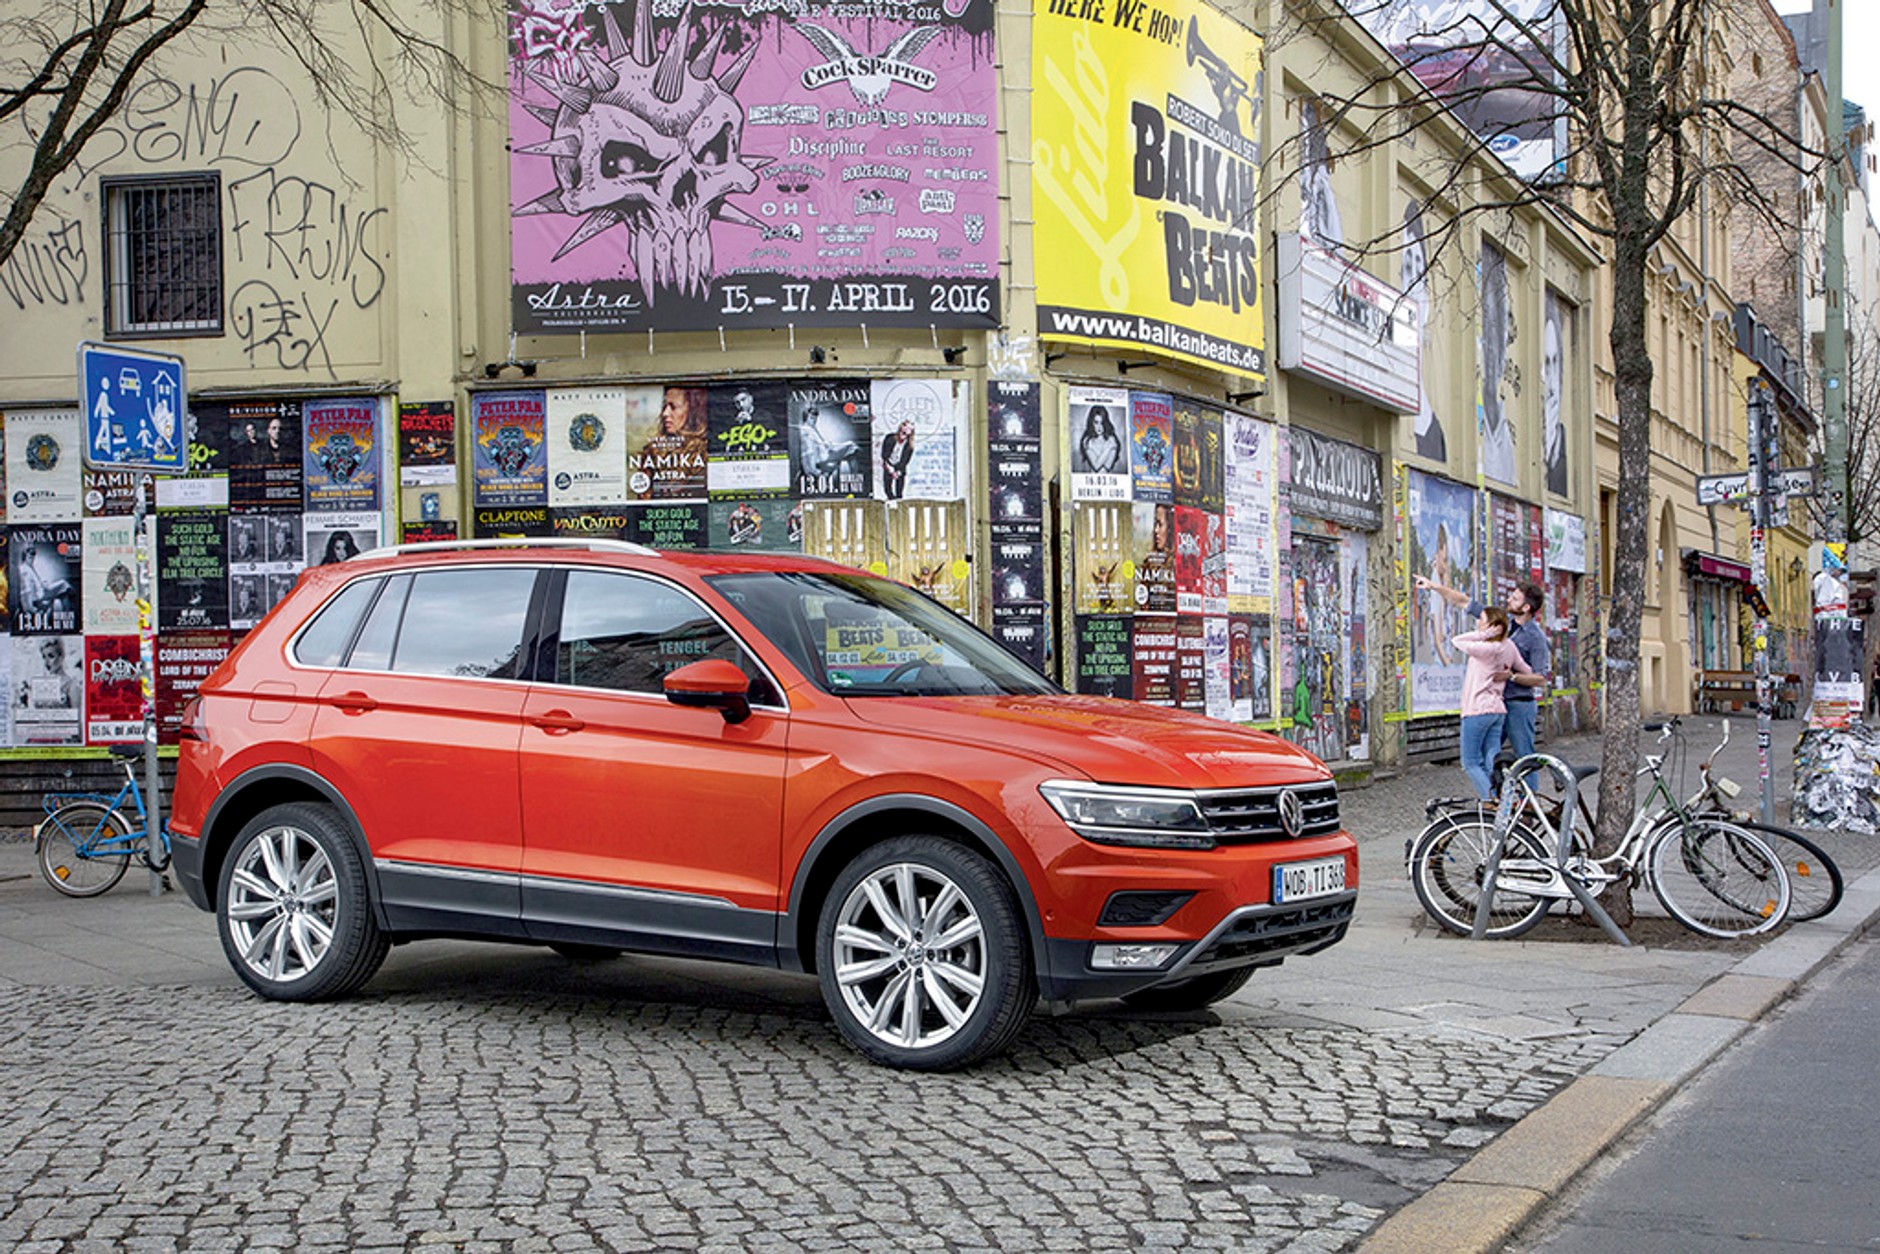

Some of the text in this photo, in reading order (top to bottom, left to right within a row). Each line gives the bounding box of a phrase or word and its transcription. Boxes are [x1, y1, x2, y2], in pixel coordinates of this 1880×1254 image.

[827, 5, 903, 19] FESTIVAL
[907, 7, 942, 21] 2016
[1113, 0, 1147, 33] WE
[1147, 9, 1184, 48] HOP!
[1168, 97, 1207, 134] ROBERT
[787, 136, 866, 160] Discipline
[886, 145, 973, 157] LAST RESORT
[1131, 100, 1255, 234] BALKAN
[1163, 210, 1257, 314] BEATS
[527, 283, 641, 310] Astra
[827, 284, 914, 312] APRIL
[930, 284, 991, 313] 2016
[1052, 311, 1261, 371] www.balkanbeats.de
[791, 389, 868, 401] ANDRA DAY
[629, 453, 705, 469] NAMIKA
[573, 472, 600, 480] ASTRA
[653, 471, 686, 480] ASTRA
[479, 509, 546, 523] CLAPTONE
[12, 530, 80, 542] ANDRA DAY
[838, 628, 884, 648] BEATS
[1284, 868, 1306, 897] WOB
